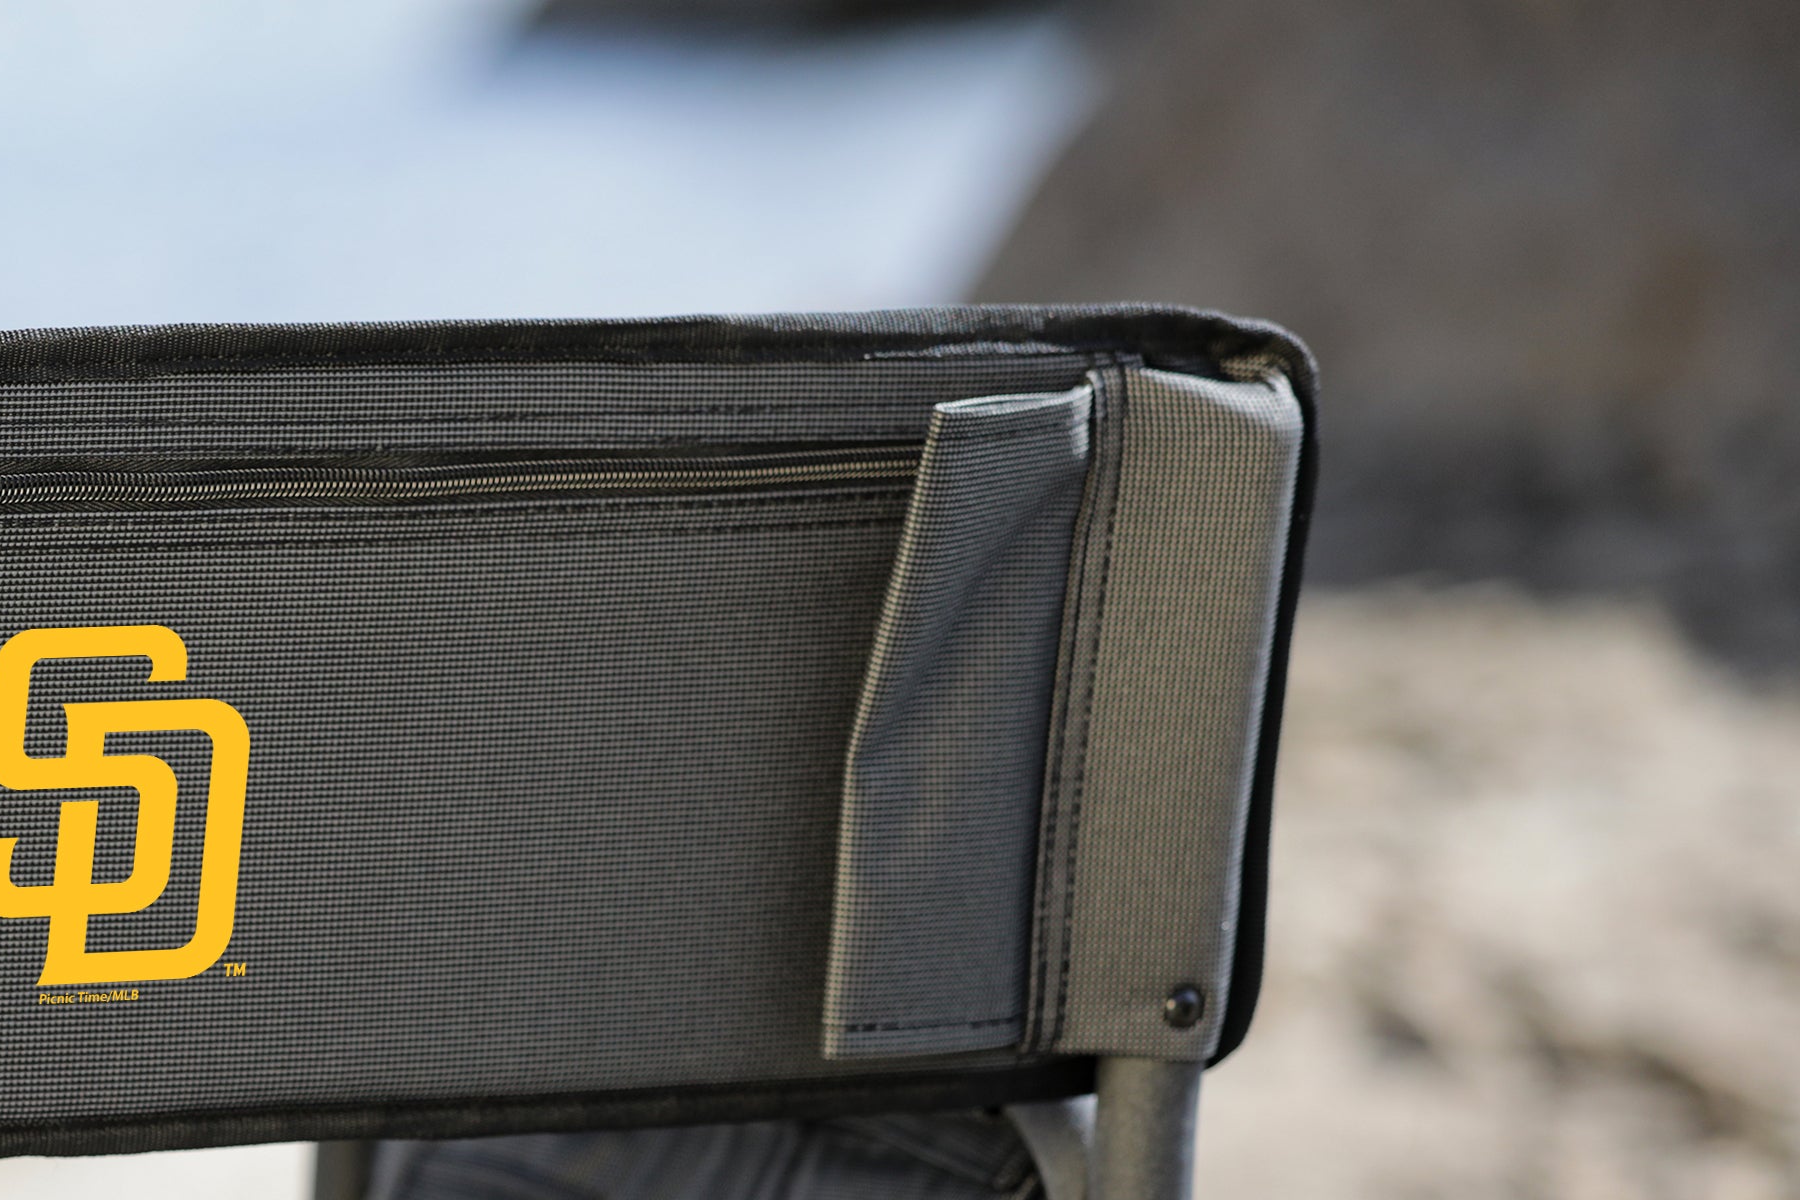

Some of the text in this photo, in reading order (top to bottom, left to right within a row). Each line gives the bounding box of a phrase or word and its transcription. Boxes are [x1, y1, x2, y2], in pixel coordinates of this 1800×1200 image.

[223, 962, 247, 977] TM
[38, 989, 140, 1005] Picnic Time/MLB
